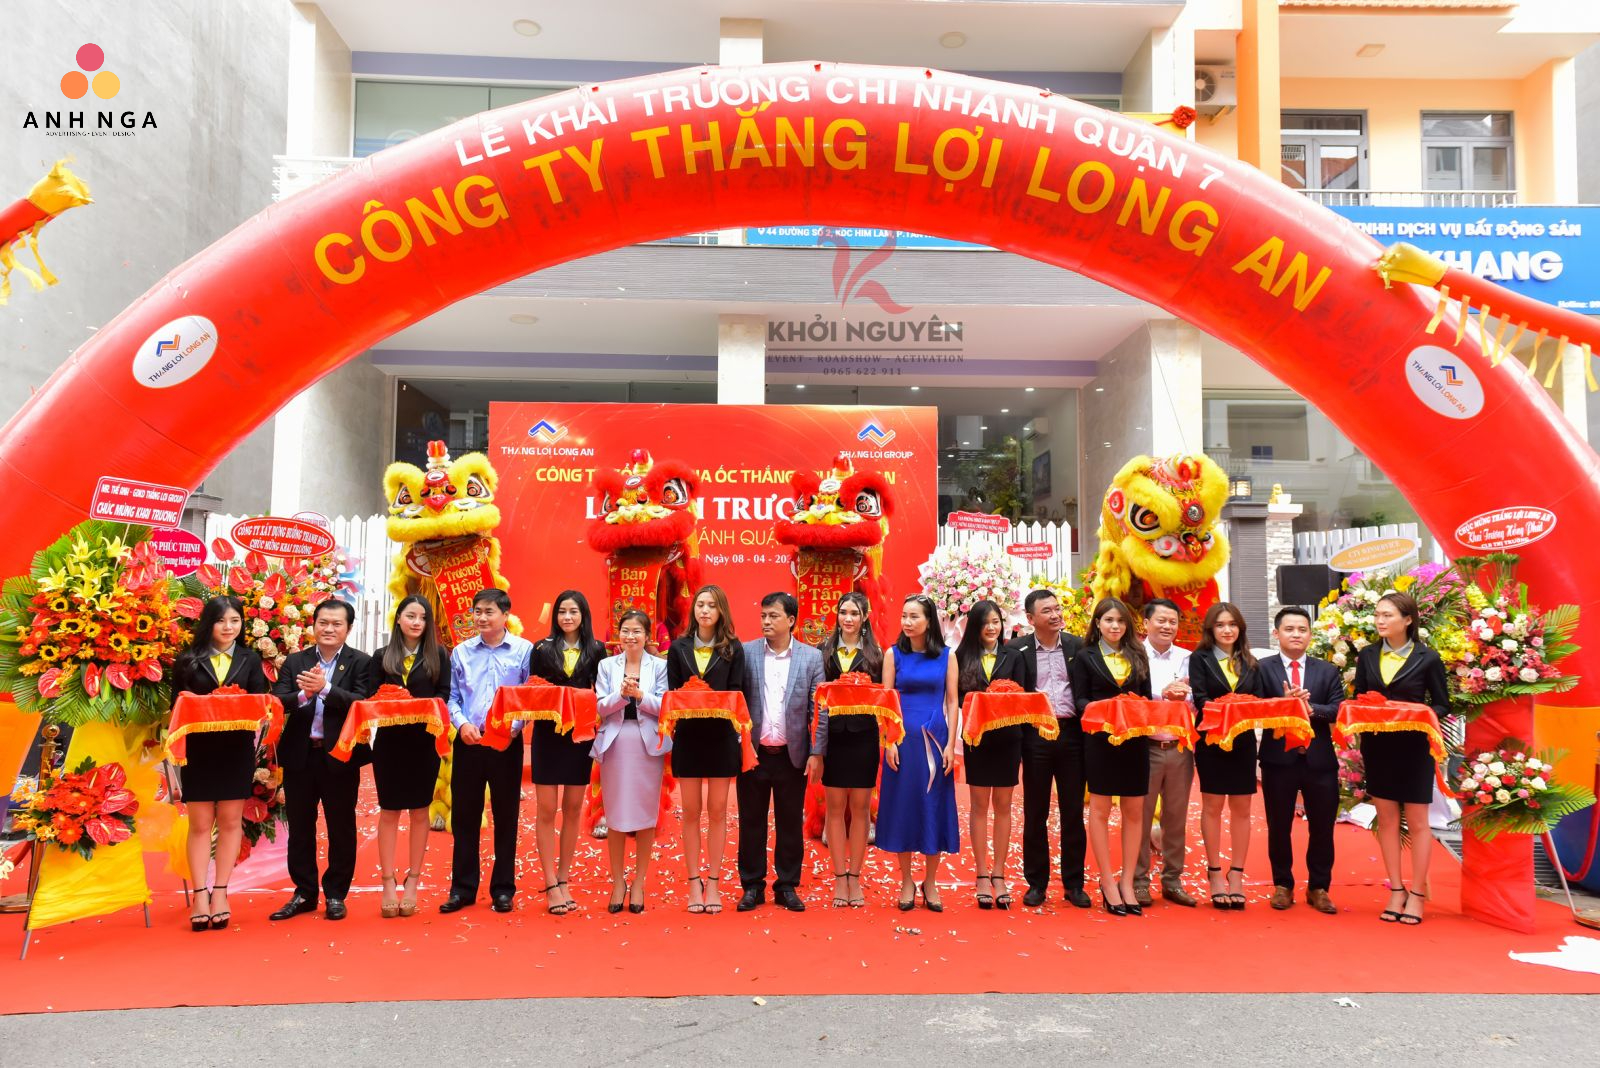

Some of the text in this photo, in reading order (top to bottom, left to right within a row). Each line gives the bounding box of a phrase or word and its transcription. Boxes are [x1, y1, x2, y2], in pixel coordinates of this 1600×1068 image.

[522, 97, 618, 145] KHAI
[826, 76, 897, 105] CHI
[1073, 116, 1188, 179] QUẬN
[1199, 162, 1225, 191] 7
[314, 100, 1333, 313] CÔNG TY THẮNG LỢI LONG AN
[766, 228, 777, 236] 44
[779, 226, 810, 237] ĐƯỜNG
[854, 229, 872, 238] HIM
[1397, 222, 1436, 239] DỊCH
[1440, 222, 1462, 239] VỤ
[1465, 218, 1493, 237] BẤT
[1496, 220, 1545, 239] ĐỘNG
[1549, 219, 1582, 237] SẢN
[182, 339, 201, 357] LONG
[553, 447, 579, 457] LONG
[580, 448, 594, 457] AN
[883, 451, 913, 460] GROUP
[536, 466, 582, 482] CÔNG
[714, 464, 738, 484] ỐC
[698, 526, 780, 549] ÁNH QUẬ
[705, 553, 729, 566] Ngày
[732, 554, 744, 563] 08
[753, 554, 766, 563] 04
[620, 566, 648, 581] Bán
[450, 576, 485, 596] Hồng
[808, 586, 842, 601] Tấn
[457, 595, 474, 611] Ph
